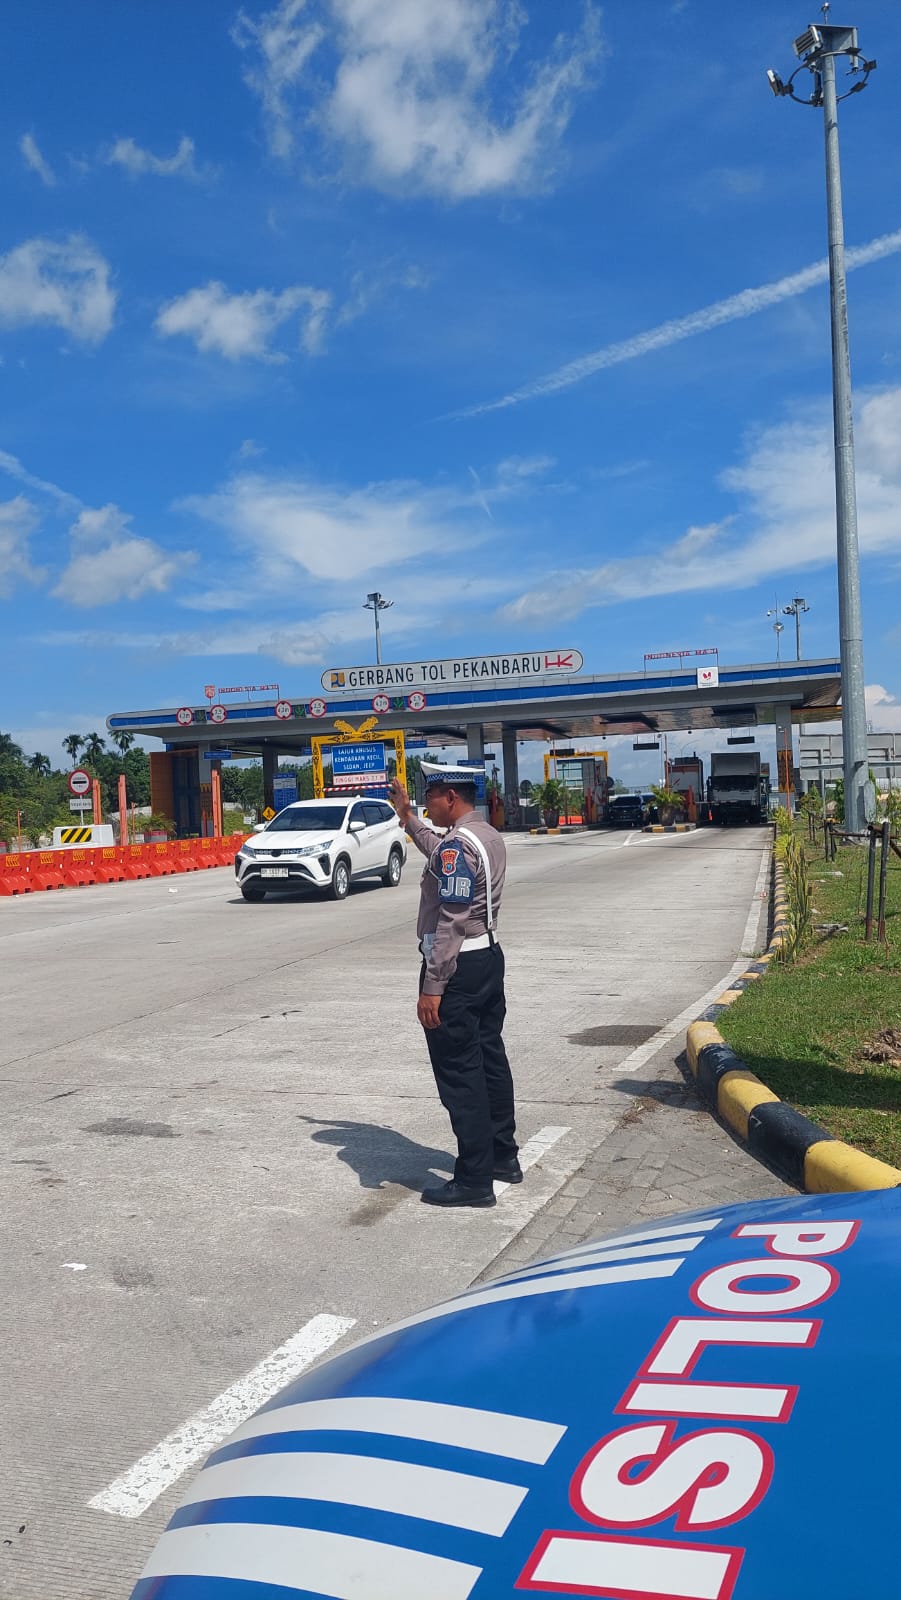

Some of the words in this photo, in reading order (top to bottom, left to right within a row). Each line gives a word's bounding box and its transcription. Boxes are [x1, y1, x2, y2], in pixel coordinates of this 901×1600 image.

[349, 667, 414, 687] GERBANG
[420, 664, 447, 681] TOL
[453, 656, 541, 679] PEKANBARU
[514, 1219, 863, 1600] POLISI
